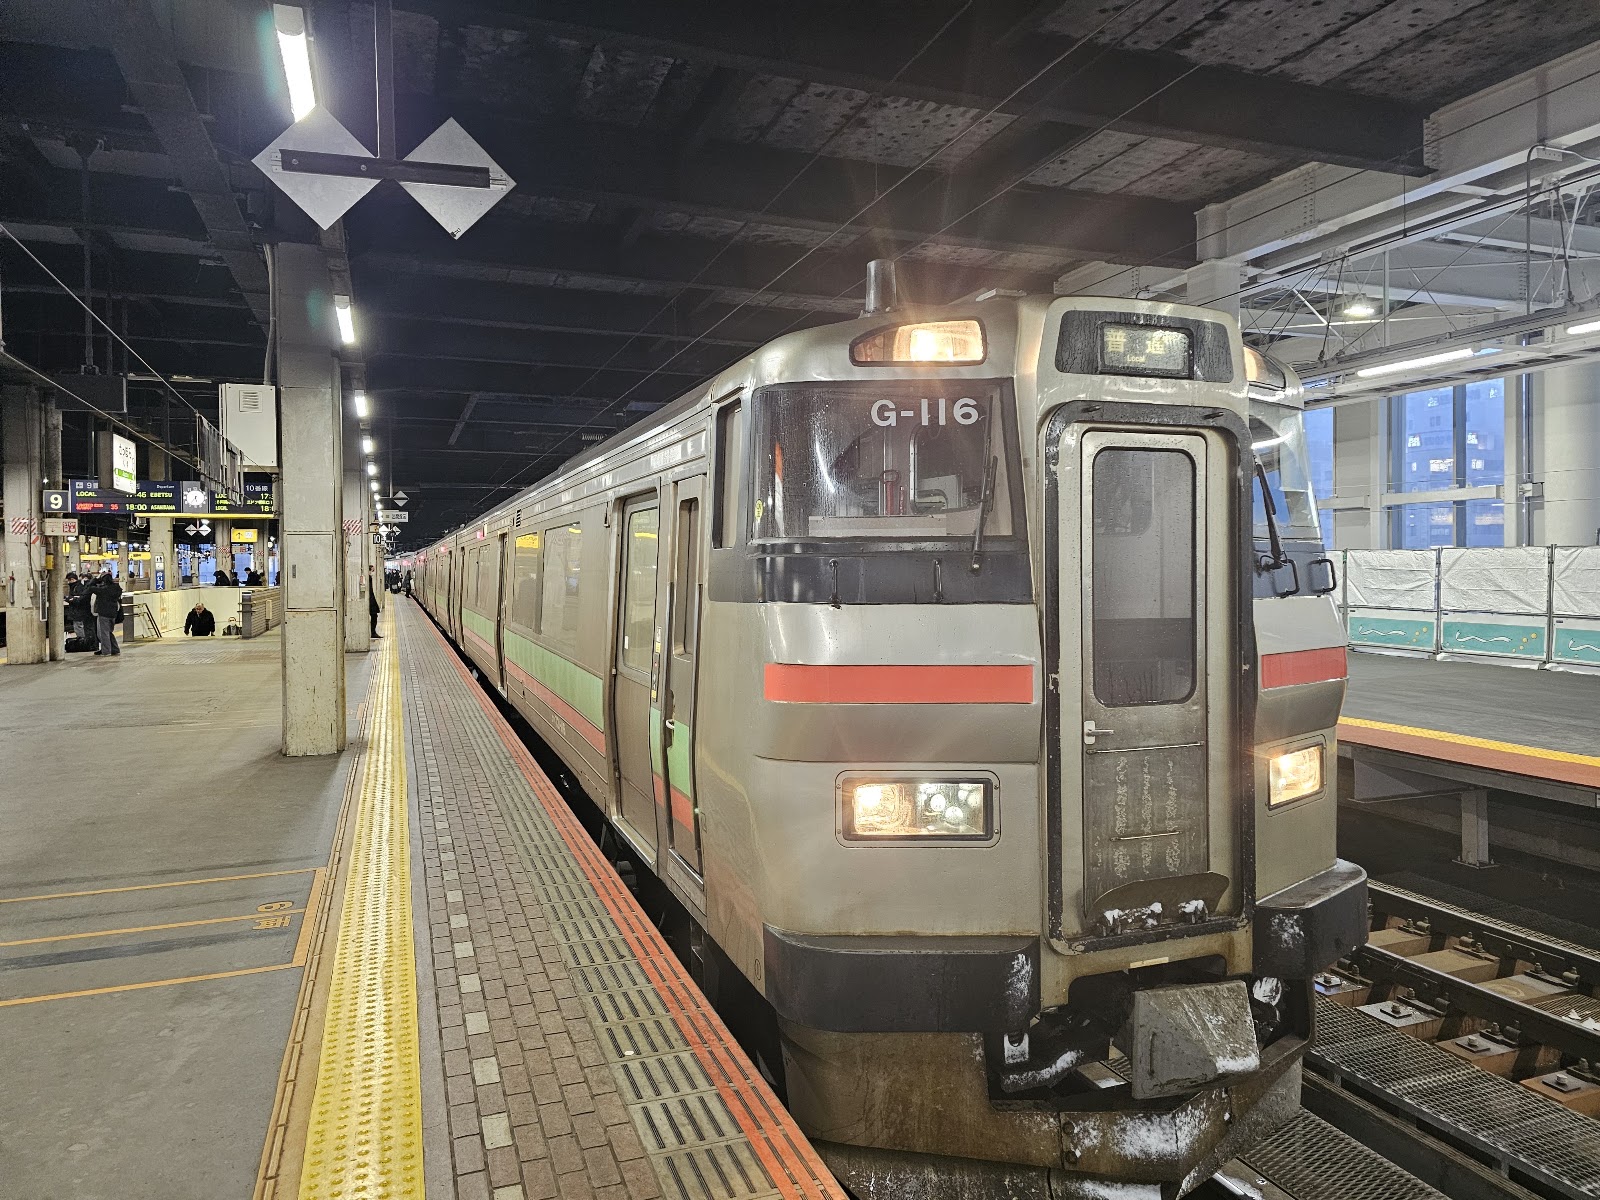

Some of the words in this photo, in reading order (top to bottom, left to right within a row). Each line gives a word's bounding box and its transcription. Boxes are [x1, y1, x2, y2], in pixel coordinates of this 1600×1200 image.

[1127, 354, 1146, 362] Local
[870, 397, 979, 427] G-116
[50, 494, 63, 510] 9
